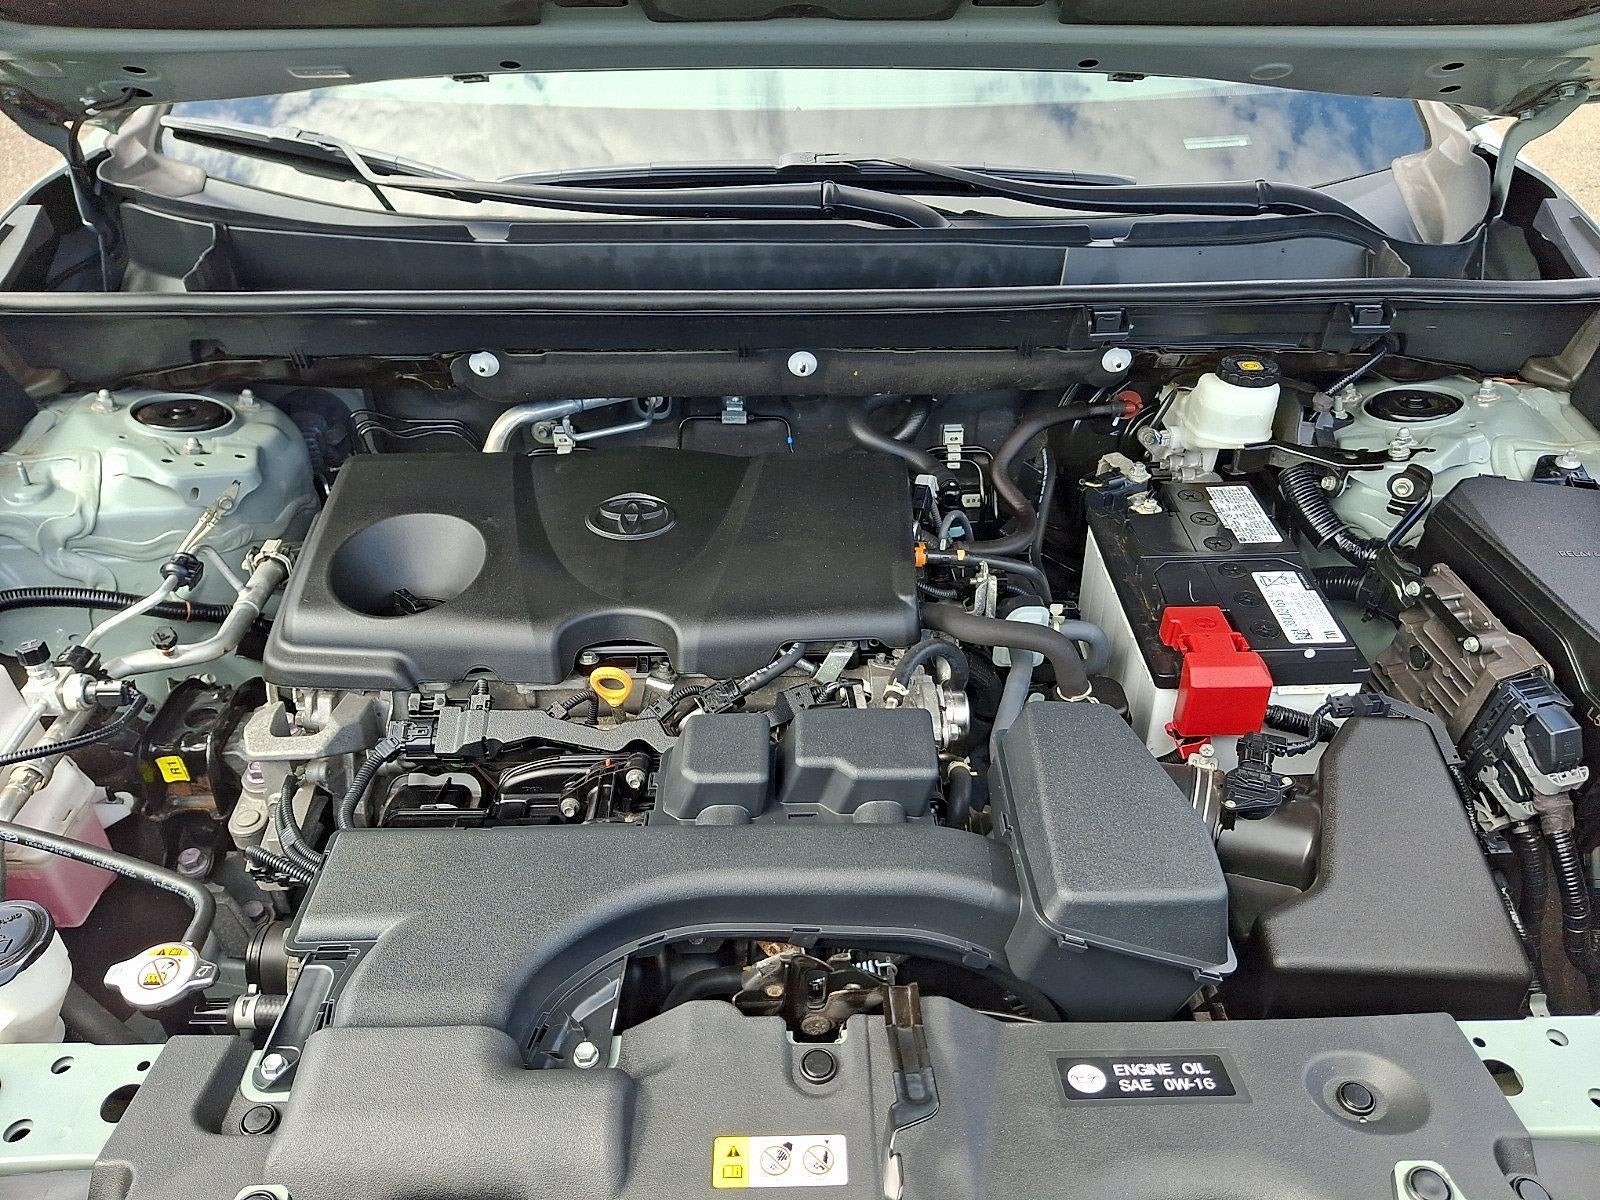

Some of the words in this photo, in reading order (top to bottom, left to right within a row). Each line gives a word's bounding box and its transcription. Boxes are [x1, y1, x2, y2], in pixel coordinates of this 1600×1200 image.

[166, 761, 182, 775] R1
[0, 912, 23, 925] LUID
[1112, 1062, 1175, 1077] ENGINE
[1181, 1061, 1211, 1076] OIL
[1118, 1079, 1156, 1092] SAE
[1163, 1077, 1217, 1091] 0W-16
